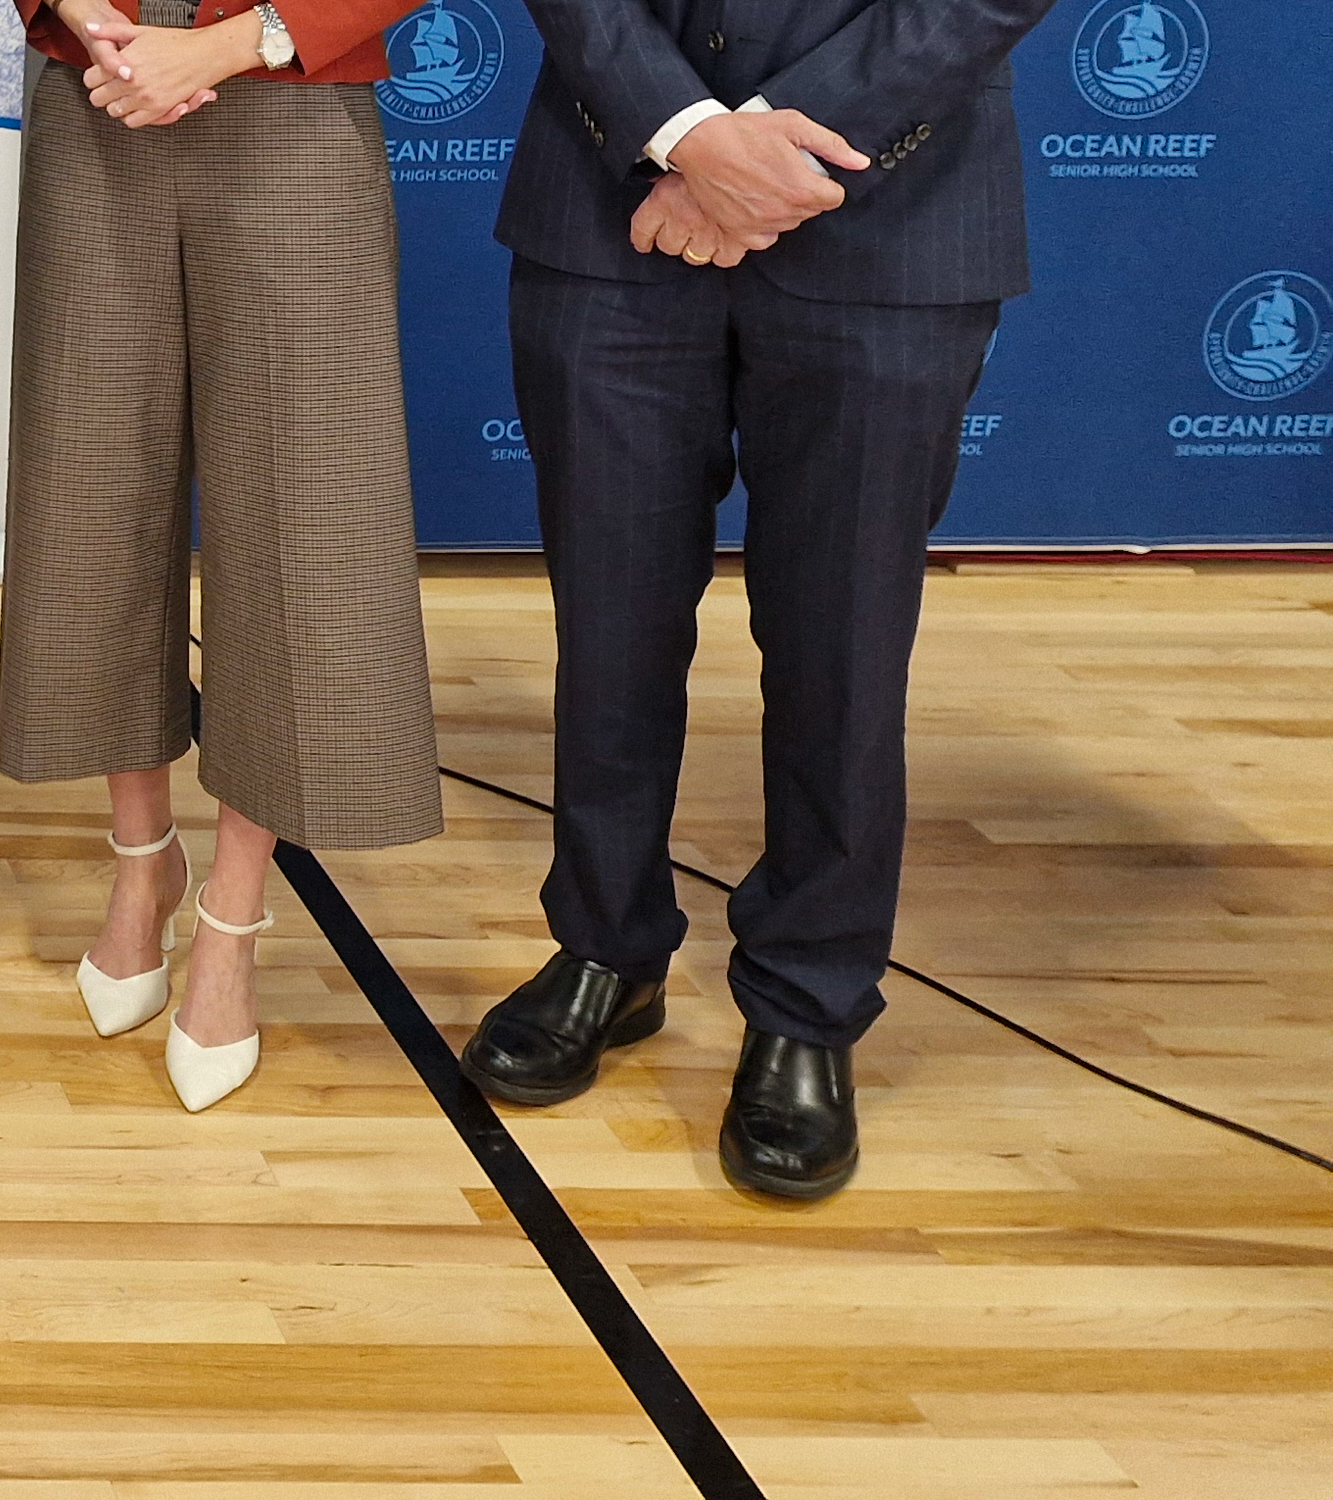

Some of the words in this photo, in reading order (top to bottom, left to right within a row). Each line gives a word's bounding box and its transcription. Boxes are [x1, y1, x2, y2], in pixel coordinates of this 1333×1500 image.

[385, 139, 439, 162] EAN
[445, 138, 516, 162] REEF
[1041, 135, 1143, 158] OCEAN
[1147, 133, 1216, 157] REEF
[400, 170, 436, 181] HIGH
[439, 169, 498, 181] SCHOOL
[1168, 414, 1268, 438] OCEAN
